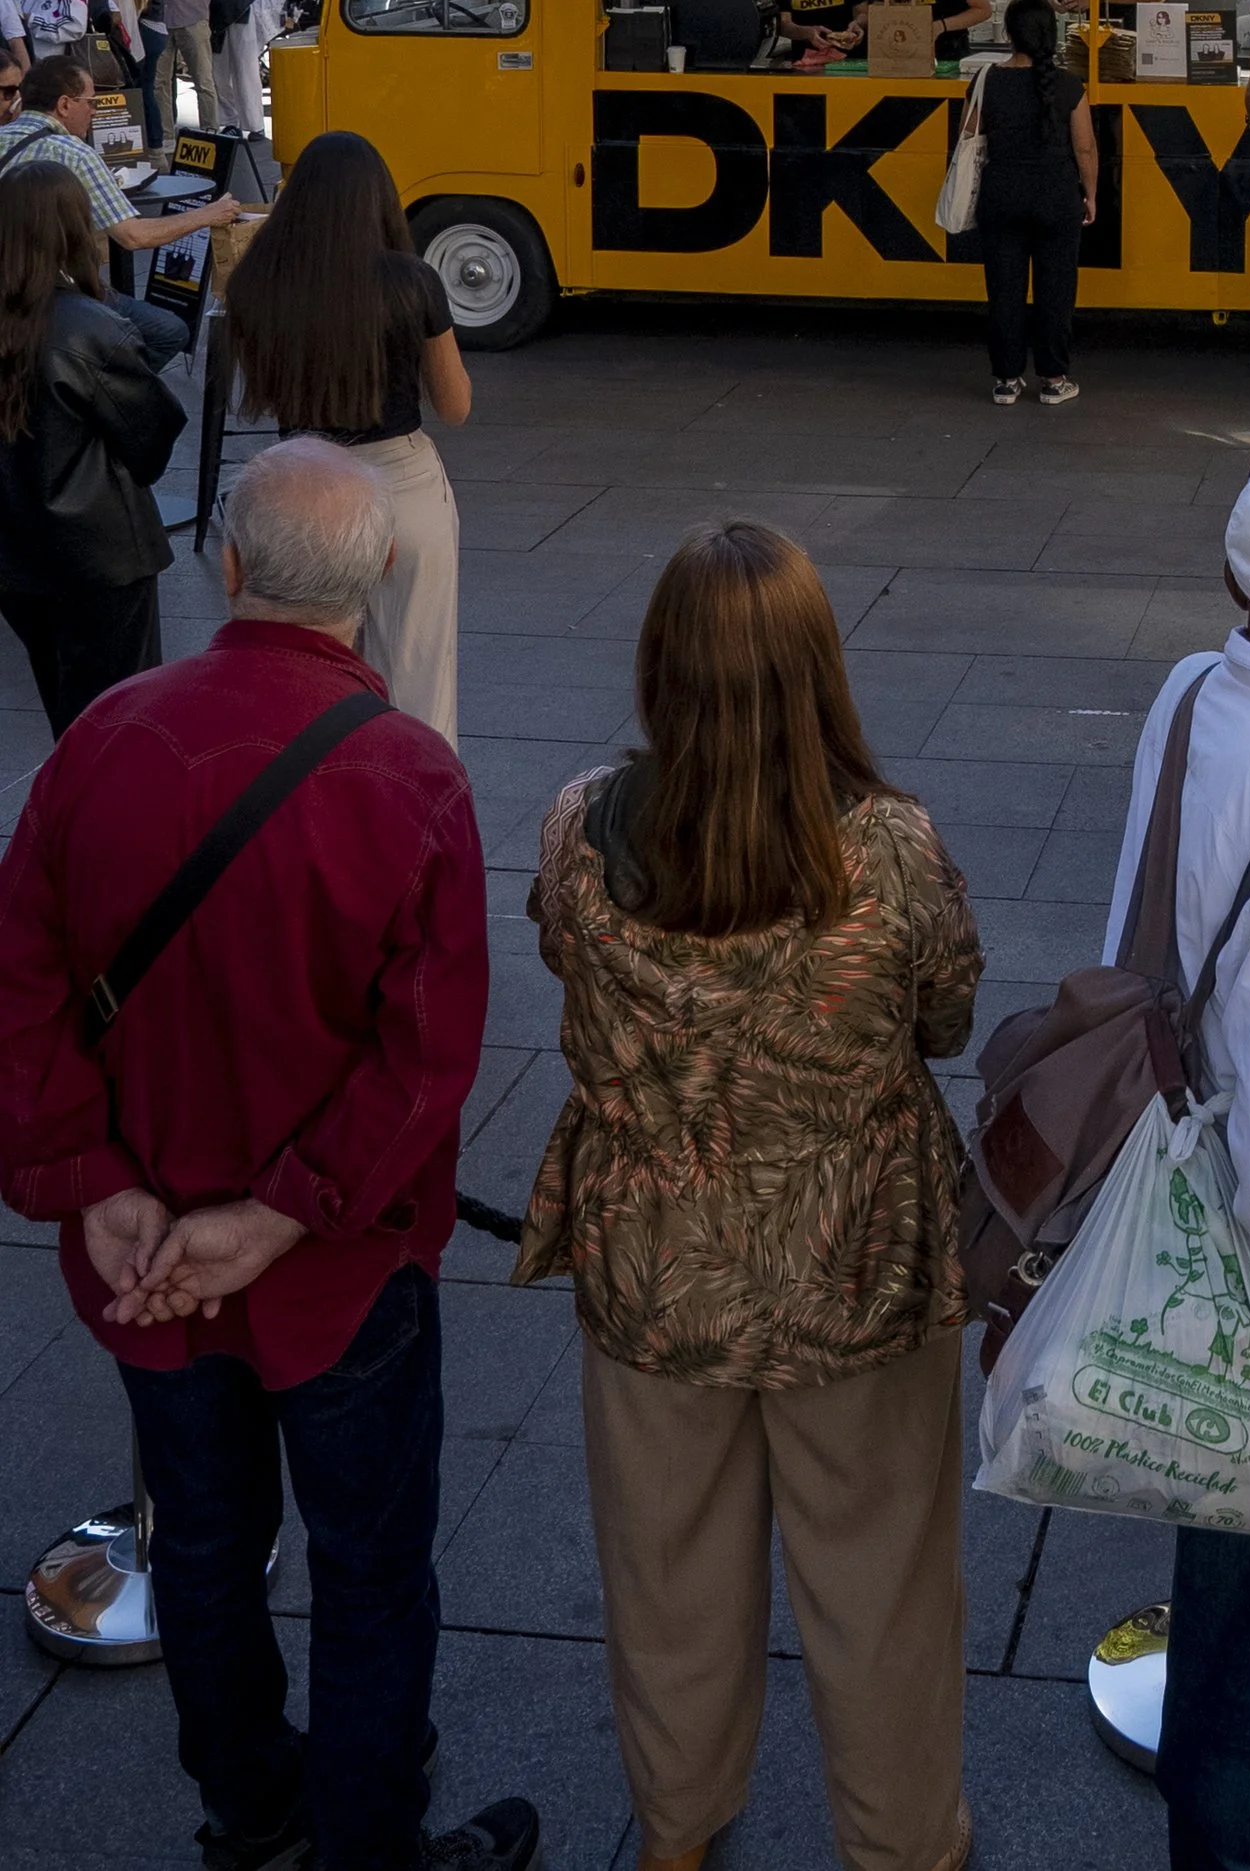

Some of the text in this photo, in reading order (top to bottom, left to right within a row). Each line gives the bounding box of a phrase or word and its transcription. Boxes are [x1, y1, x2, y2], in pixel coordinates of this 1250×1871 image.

[179, 142, 211, 165] DKNY
[1088, 1378, 1173, 1426] El Club
[1063, 1429, 1104, 1454] 100%
[1164, 1460, 1238, 1495] Reciclado
